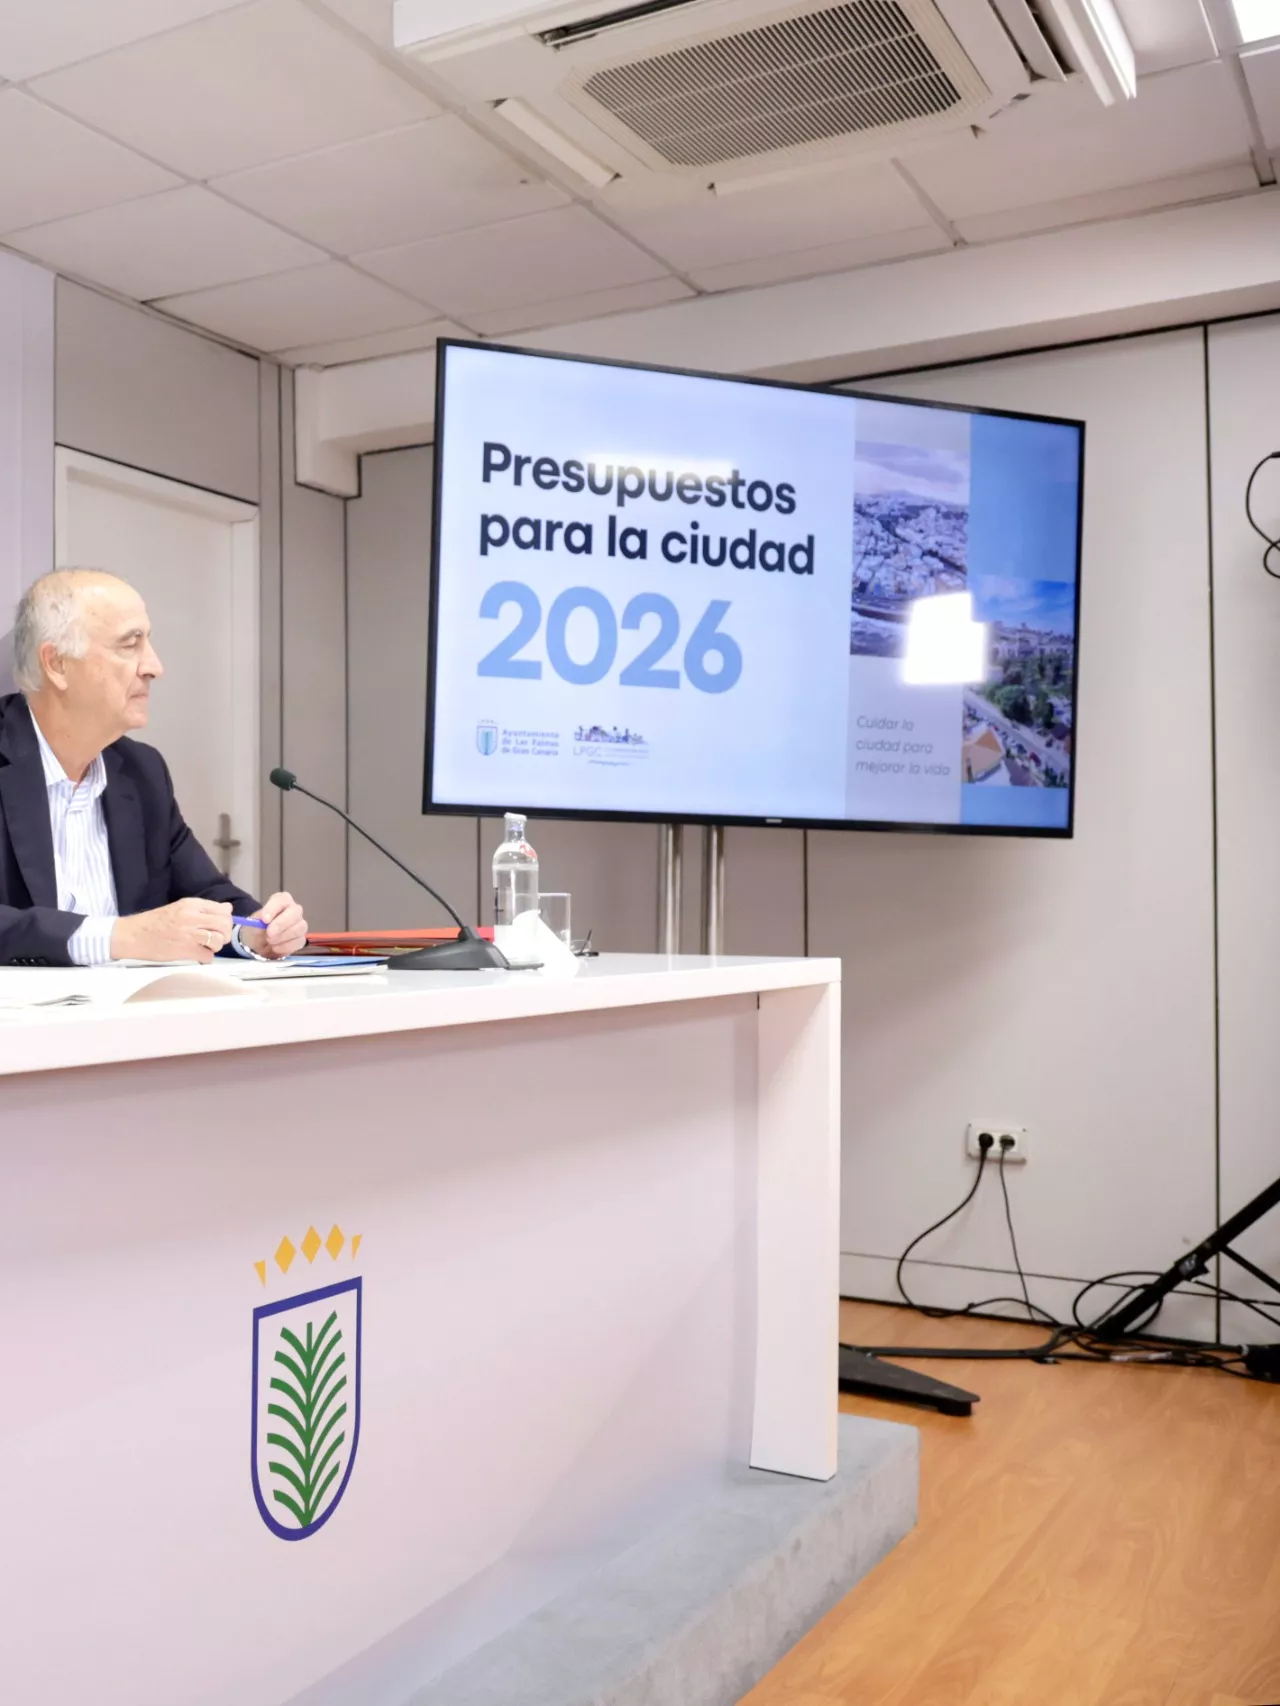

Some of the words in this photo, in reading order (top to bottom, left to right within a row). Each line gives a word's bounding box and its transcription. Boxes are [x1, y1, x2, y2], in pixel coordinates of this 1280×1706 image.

[482, 441, 796, 515] Presupuestos
[480, 513, 593, 556] para
[607, 515, 648, 560] la
[661, 520, 815, 575] ciudad
[477, 580, 743, 694] 2026
[857, 716, 899, 730] Cuidar
[902, 718, 915, 731] la
[855, 739, 901, 753] ciudad
[902, 741, 934, 755] para
[855, 760, 905, 775] mejorar
[909, 761, 921, 774] la
[924, 762, 951, 776] vida
